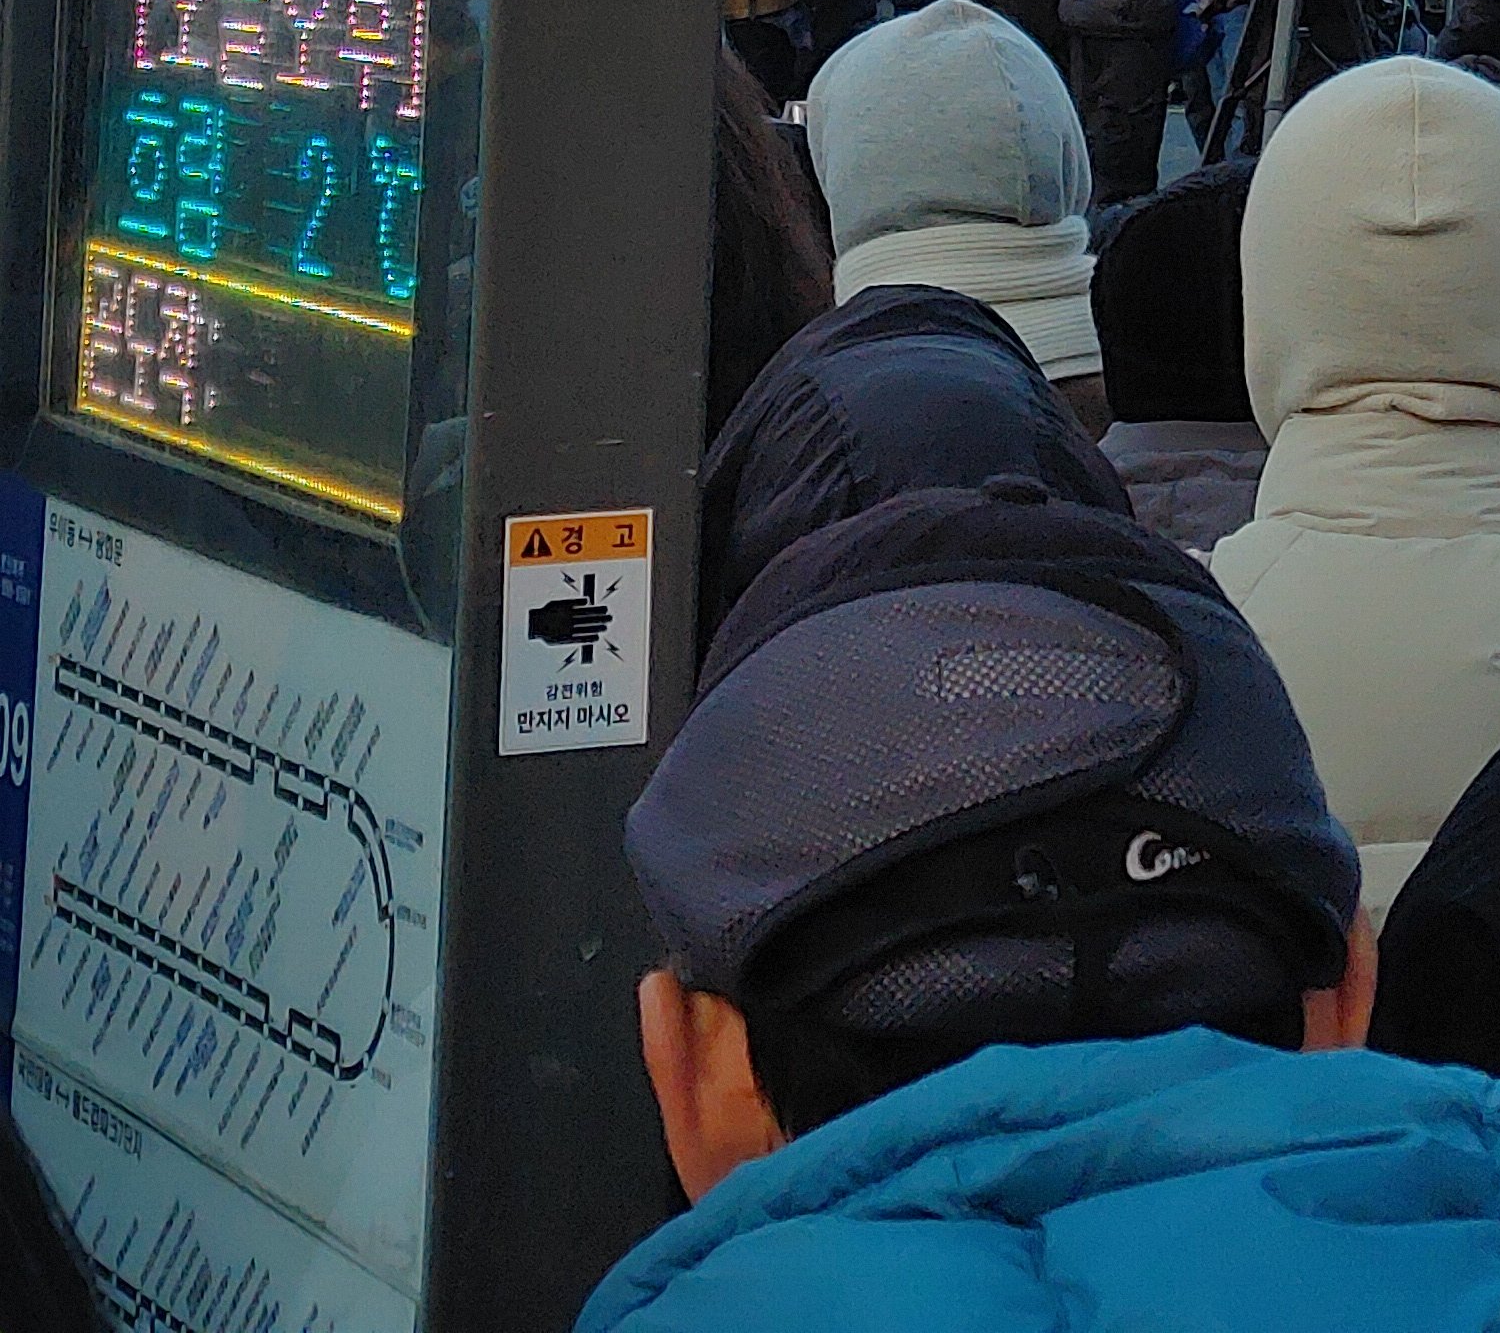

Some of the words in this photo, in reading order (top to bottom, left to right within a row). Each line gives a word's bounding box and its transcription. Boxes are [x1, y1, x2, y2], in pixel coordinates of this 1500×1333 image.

[546, 681, 603, 701] 감전위험
[517, 706, 570, 733] 만지지
[577, 703, 630, 728] 마시오
